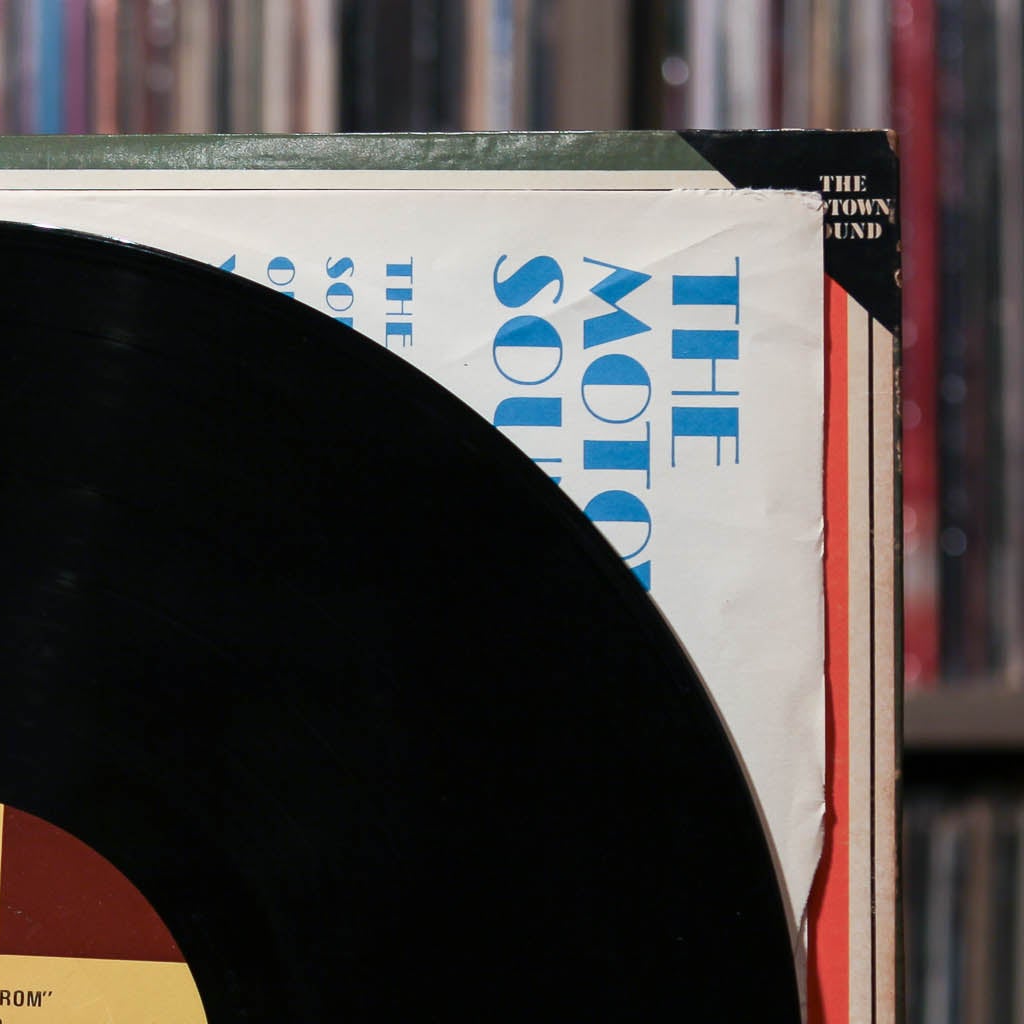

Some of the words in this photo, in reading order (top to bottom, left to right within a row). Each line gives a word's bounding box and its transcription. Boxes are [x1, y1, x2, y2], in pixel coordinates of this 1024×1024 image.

[819, 175, 867, 192] THE
[823, 198, 891, 216] TOWN
[825, 222, 883, 240] UND
[385, 256, 413, 349] THE
[492, 255, 564, 486] SOU
[671, 256, 740, 468] THE
[579, 256, 652, 592] MOTO
